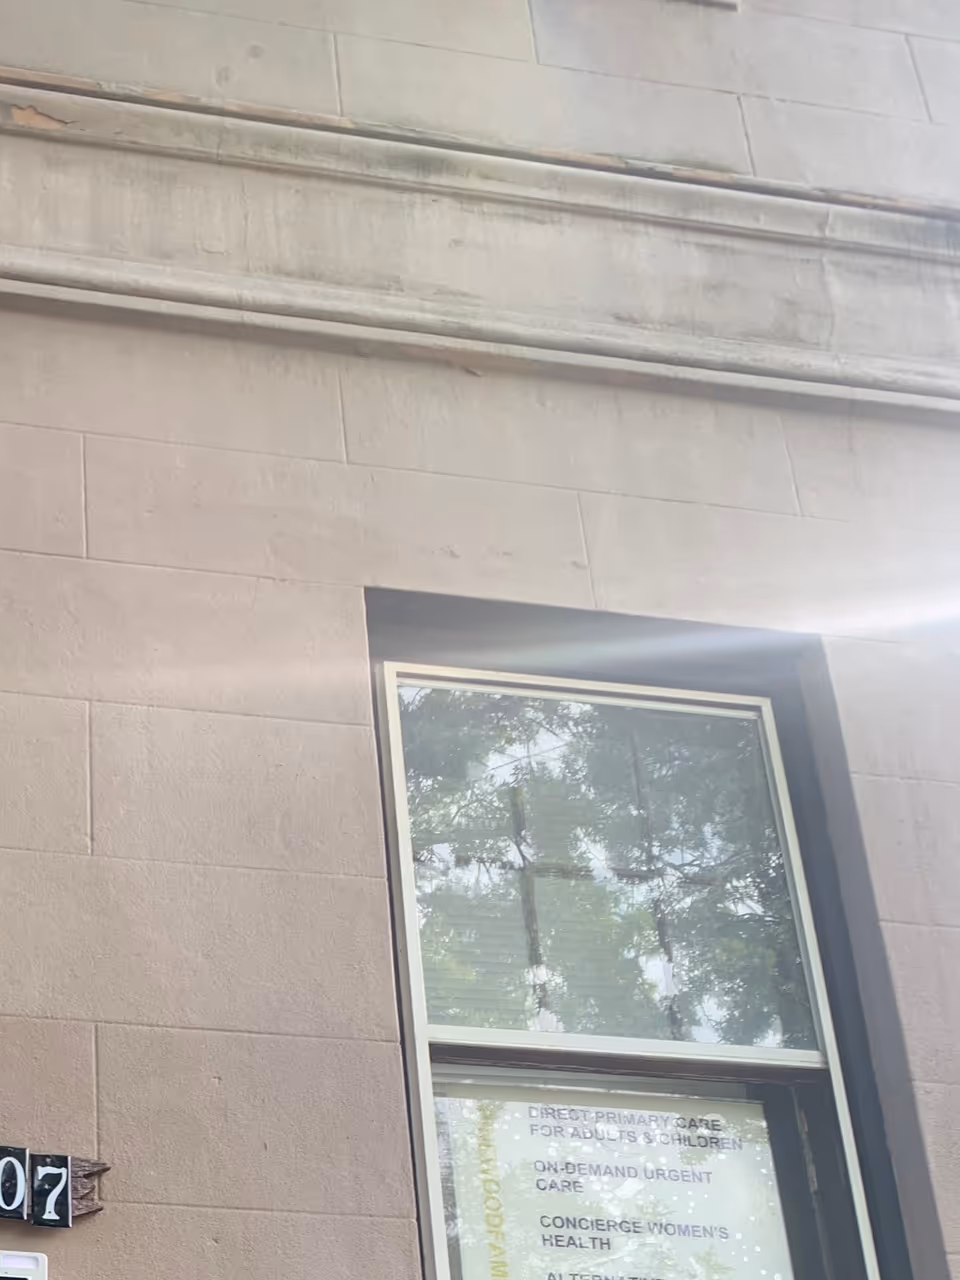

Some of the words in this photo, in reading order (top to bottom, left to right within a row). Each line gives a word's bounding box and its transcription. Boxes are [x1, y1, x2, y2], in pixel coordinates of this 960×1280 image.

[528, 1105, 589, 1122] DIRECT
[595, 1110, 670, 1128] PRIMARY
[673, 1116, 722, 1132] CARE
[529, 1123, 565, 1138] FOR
[570, 1126, 637, 1143] ADULTS
[642, 1132, 654, 1145] &
[659, 1133, 743, 1150] CHILDREN
[534, 1159, 639, 1179] ON-DEMAND
[643, 1166, 713, 1184] URGENT
[535, 1178, 584, 1193] CARE
[539, 1215, 644, 1234] CONCIERGE
[647, 1221, 730, 1240] WOMEN'S
[541, 1234, 611, 1250] HEALTH
